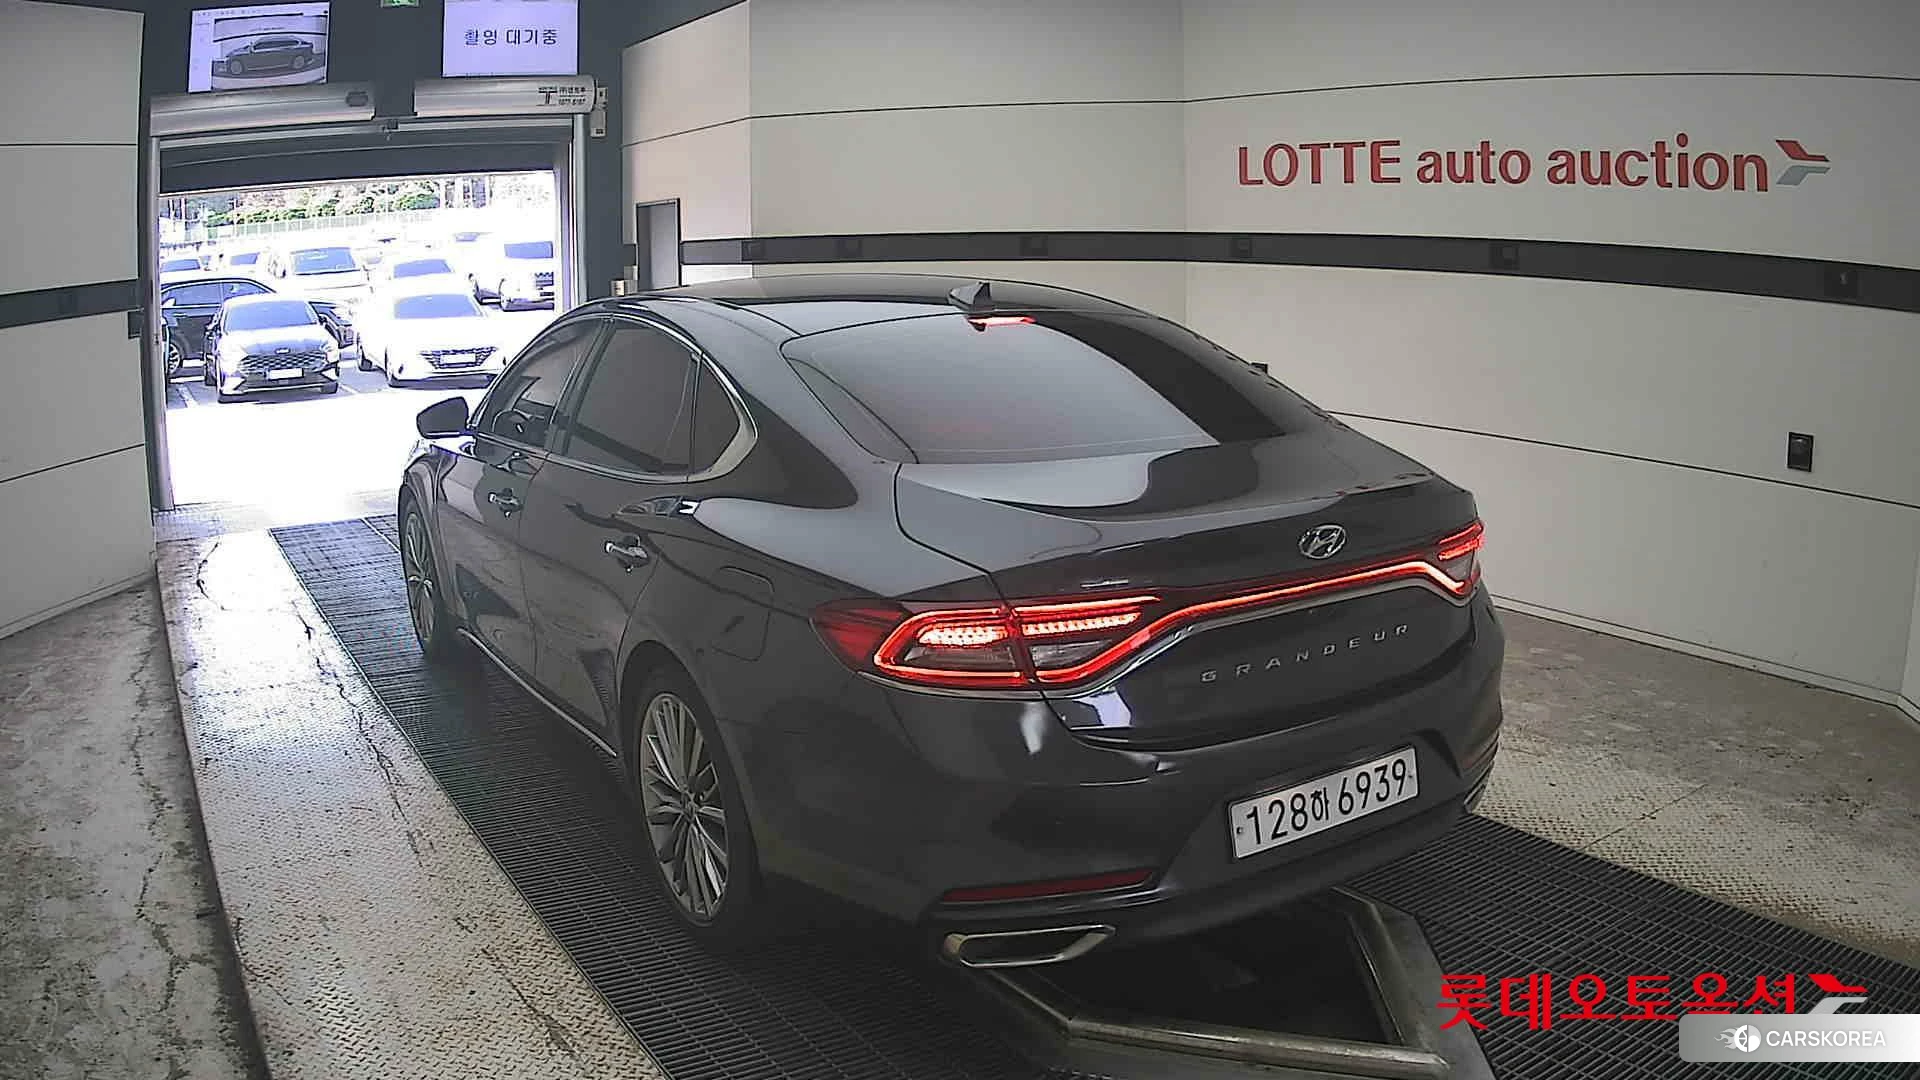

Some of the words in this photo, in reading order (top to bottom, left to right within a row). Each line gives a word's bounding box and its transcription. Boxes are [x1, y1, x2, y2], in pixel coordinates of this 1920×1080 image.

[506, 29, 558, 46] 대기중
[1238, 140, 1401, 187] LOTTE
[1416, 141, 1532, 185] auto
[1547, 133, 1769, 192] auction
[1201, 624, 1409, 682] GRANDEUR
[1246, 786, 1330, 845] 128하
[1338, 758, 1407, 816] 6939
